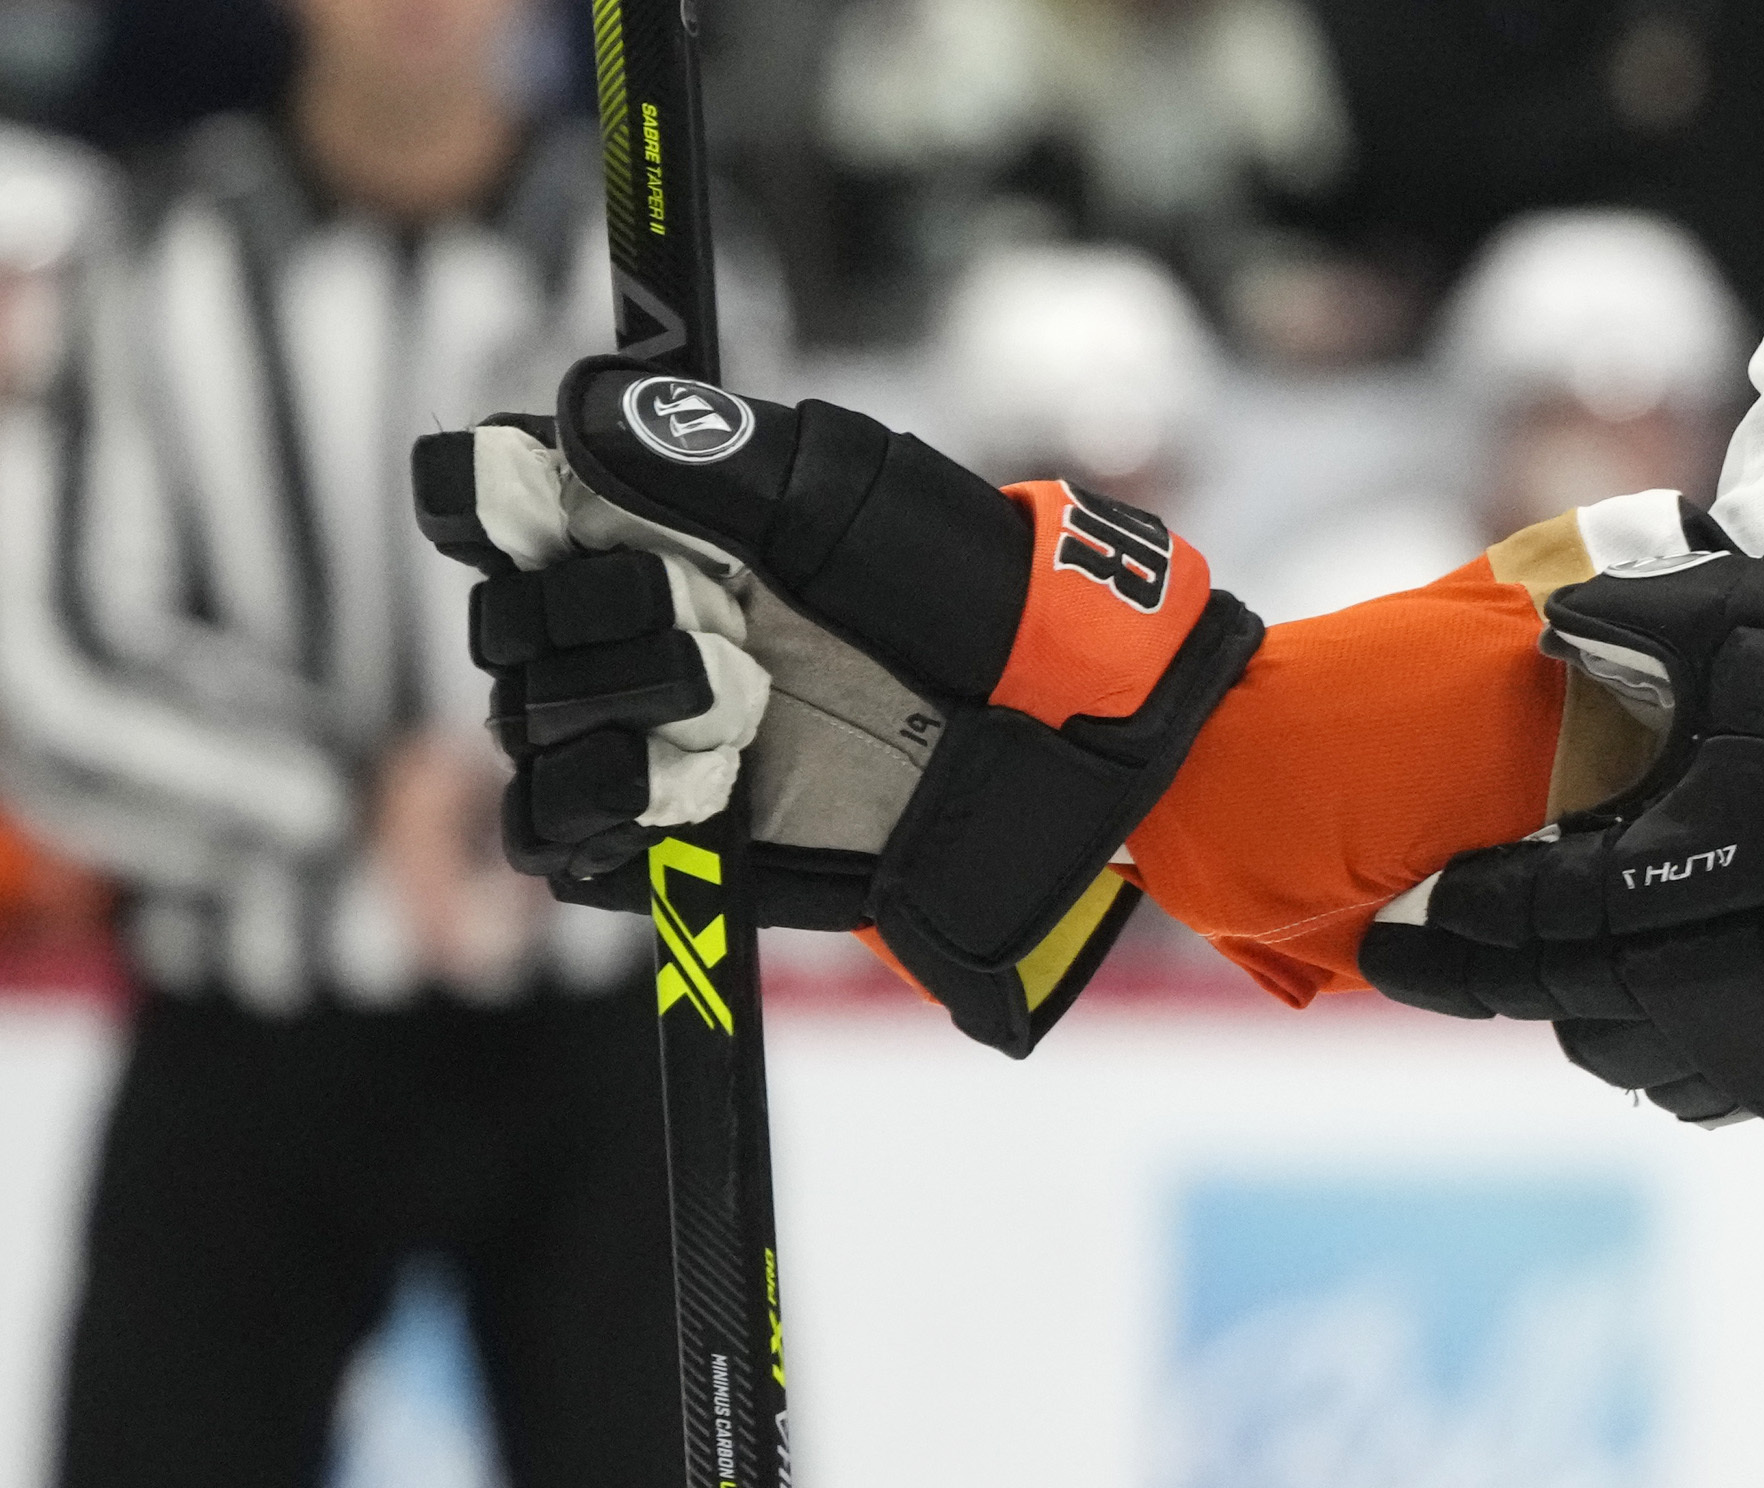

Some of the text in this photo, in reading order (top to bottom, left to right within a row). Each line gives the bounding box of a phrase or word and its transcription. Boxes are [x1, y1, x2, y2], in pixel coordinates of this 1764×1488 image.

[641, 102, 661, 163] SABRE
[646, 165, 665, 221] TAPER
[900, 712, 941, 748] 19
[649, 837, 734, 1036] LX
[764, 1247, 777, 1307] PRO
[711, 1352, 731, 1417] MINIMUS
[715, 1416, 736, 1480] CARBON
